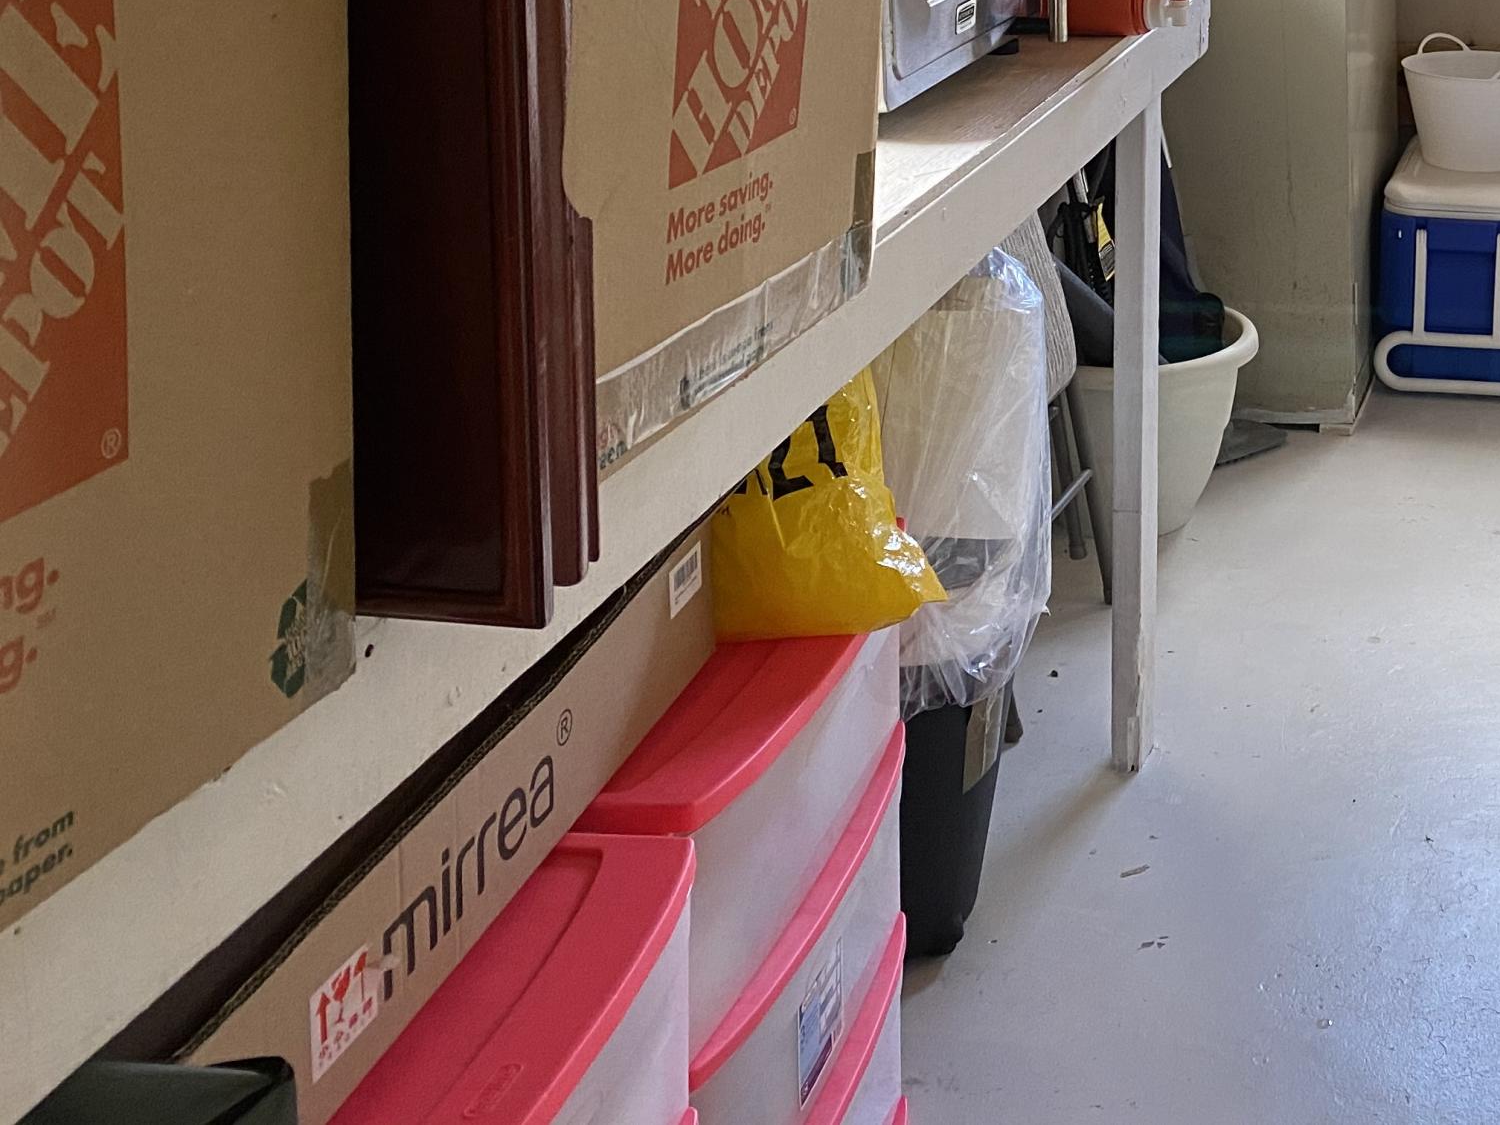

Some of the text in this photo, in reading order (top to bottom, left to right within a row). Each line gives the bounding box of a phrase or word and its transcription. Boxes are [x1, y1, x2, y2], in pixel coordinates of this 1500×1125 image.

[666, 171, 774, 245] More saving.
[664, 213, 766, 286] More doing.
[13, 810, 75, 865] from
[382, 753, 555, 1002] mirrea
